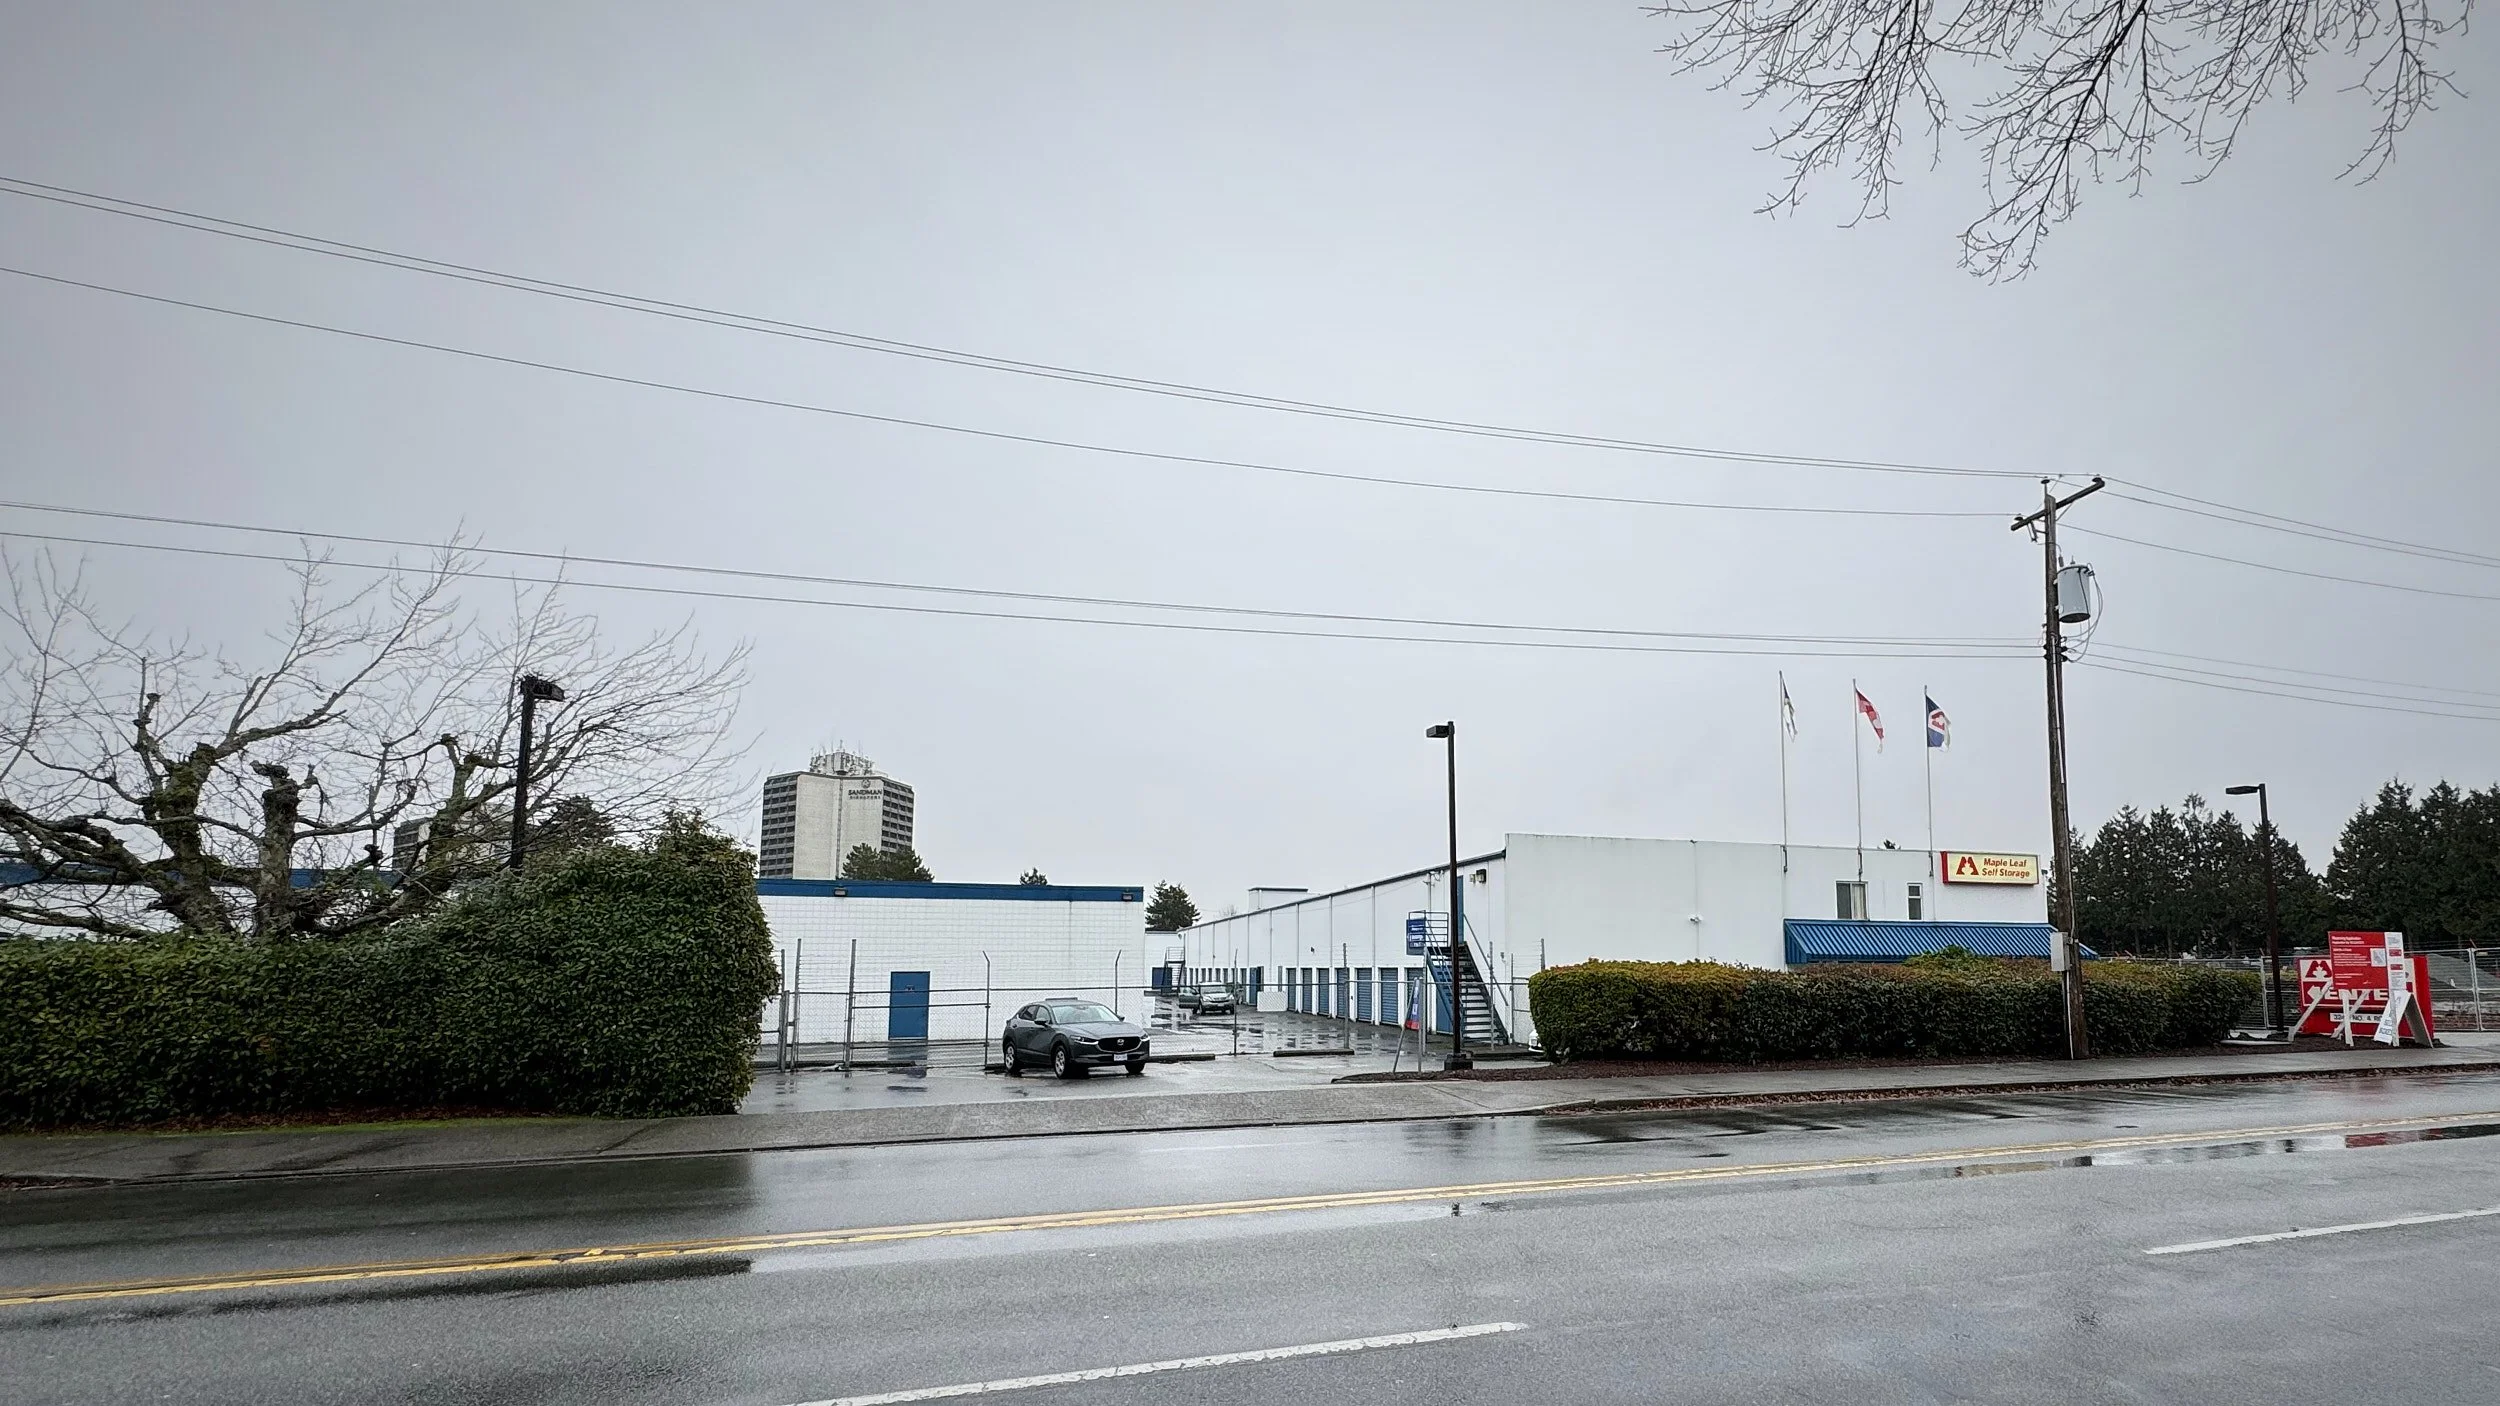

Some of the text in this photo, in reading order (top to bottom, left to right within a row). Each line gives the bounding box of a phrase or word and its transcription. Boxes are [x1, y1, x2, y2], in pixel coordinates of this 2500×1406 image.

[1983, 858, 2027, 867] Maple Leaf
[1982, 868, 2030, 878] Self Storage
